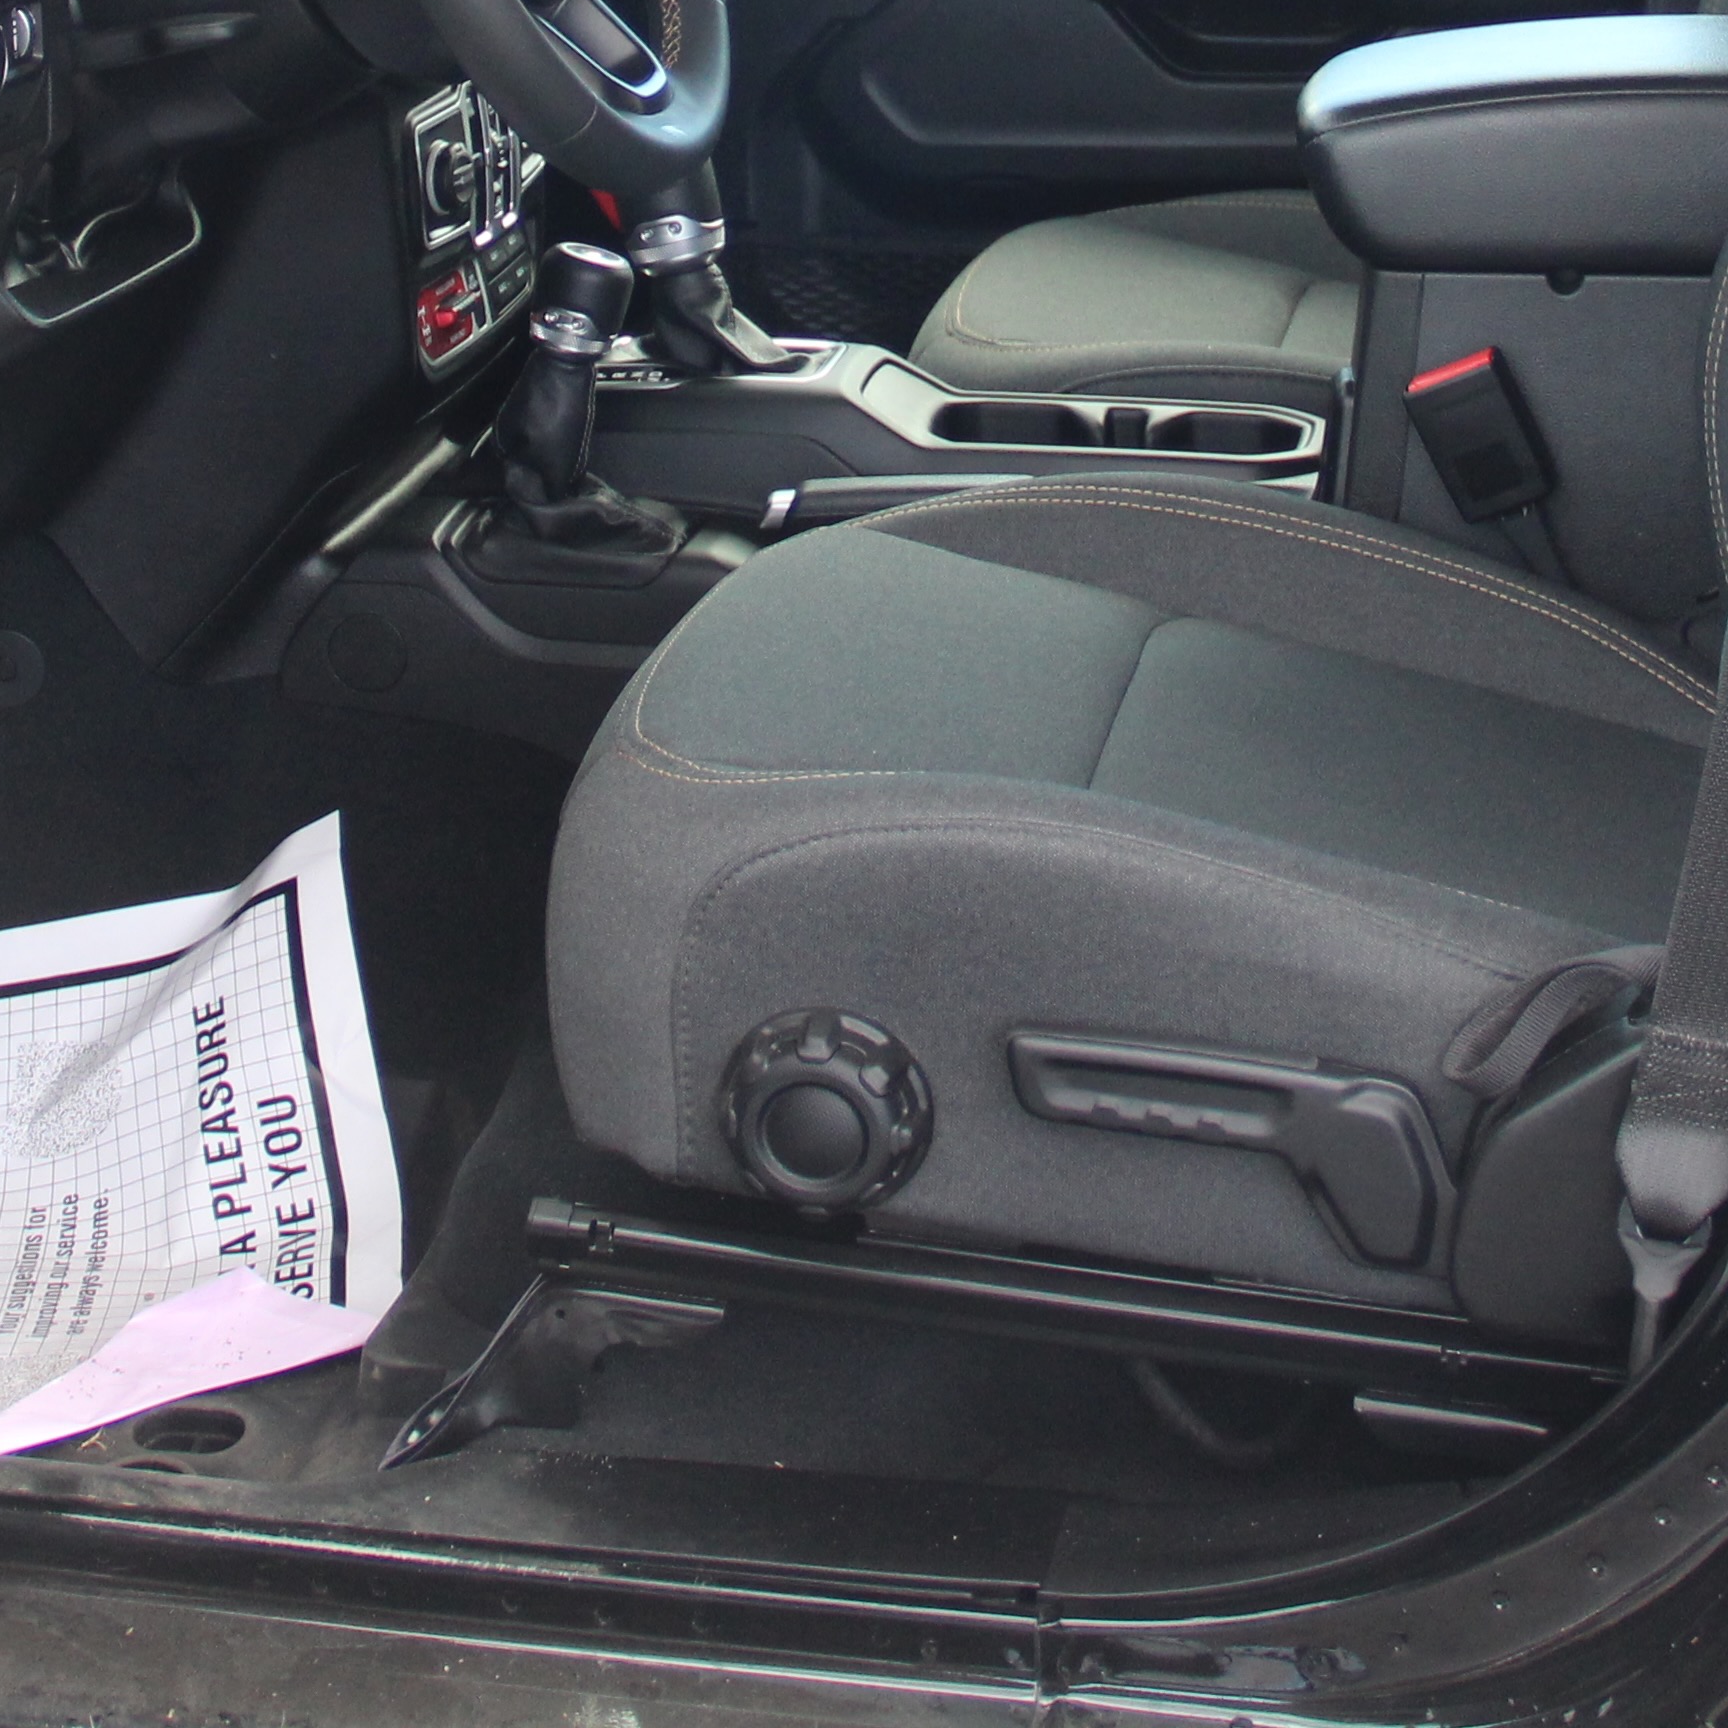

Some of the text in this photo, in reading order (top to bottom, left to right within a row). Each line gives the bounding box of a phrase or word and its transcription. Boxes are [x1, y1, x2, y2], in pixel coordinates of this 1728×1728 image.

[193, 995, 257, 1256] A PLEASURE
[257, 1094, 308, 1191] YOU
[7, 1234, 42, 1311] suggestions
[24, 1207, 47, 1230] for
[26, 1193, 79, 1338] improving our service
[66, 1188, 109, 1335] are always welcome.
